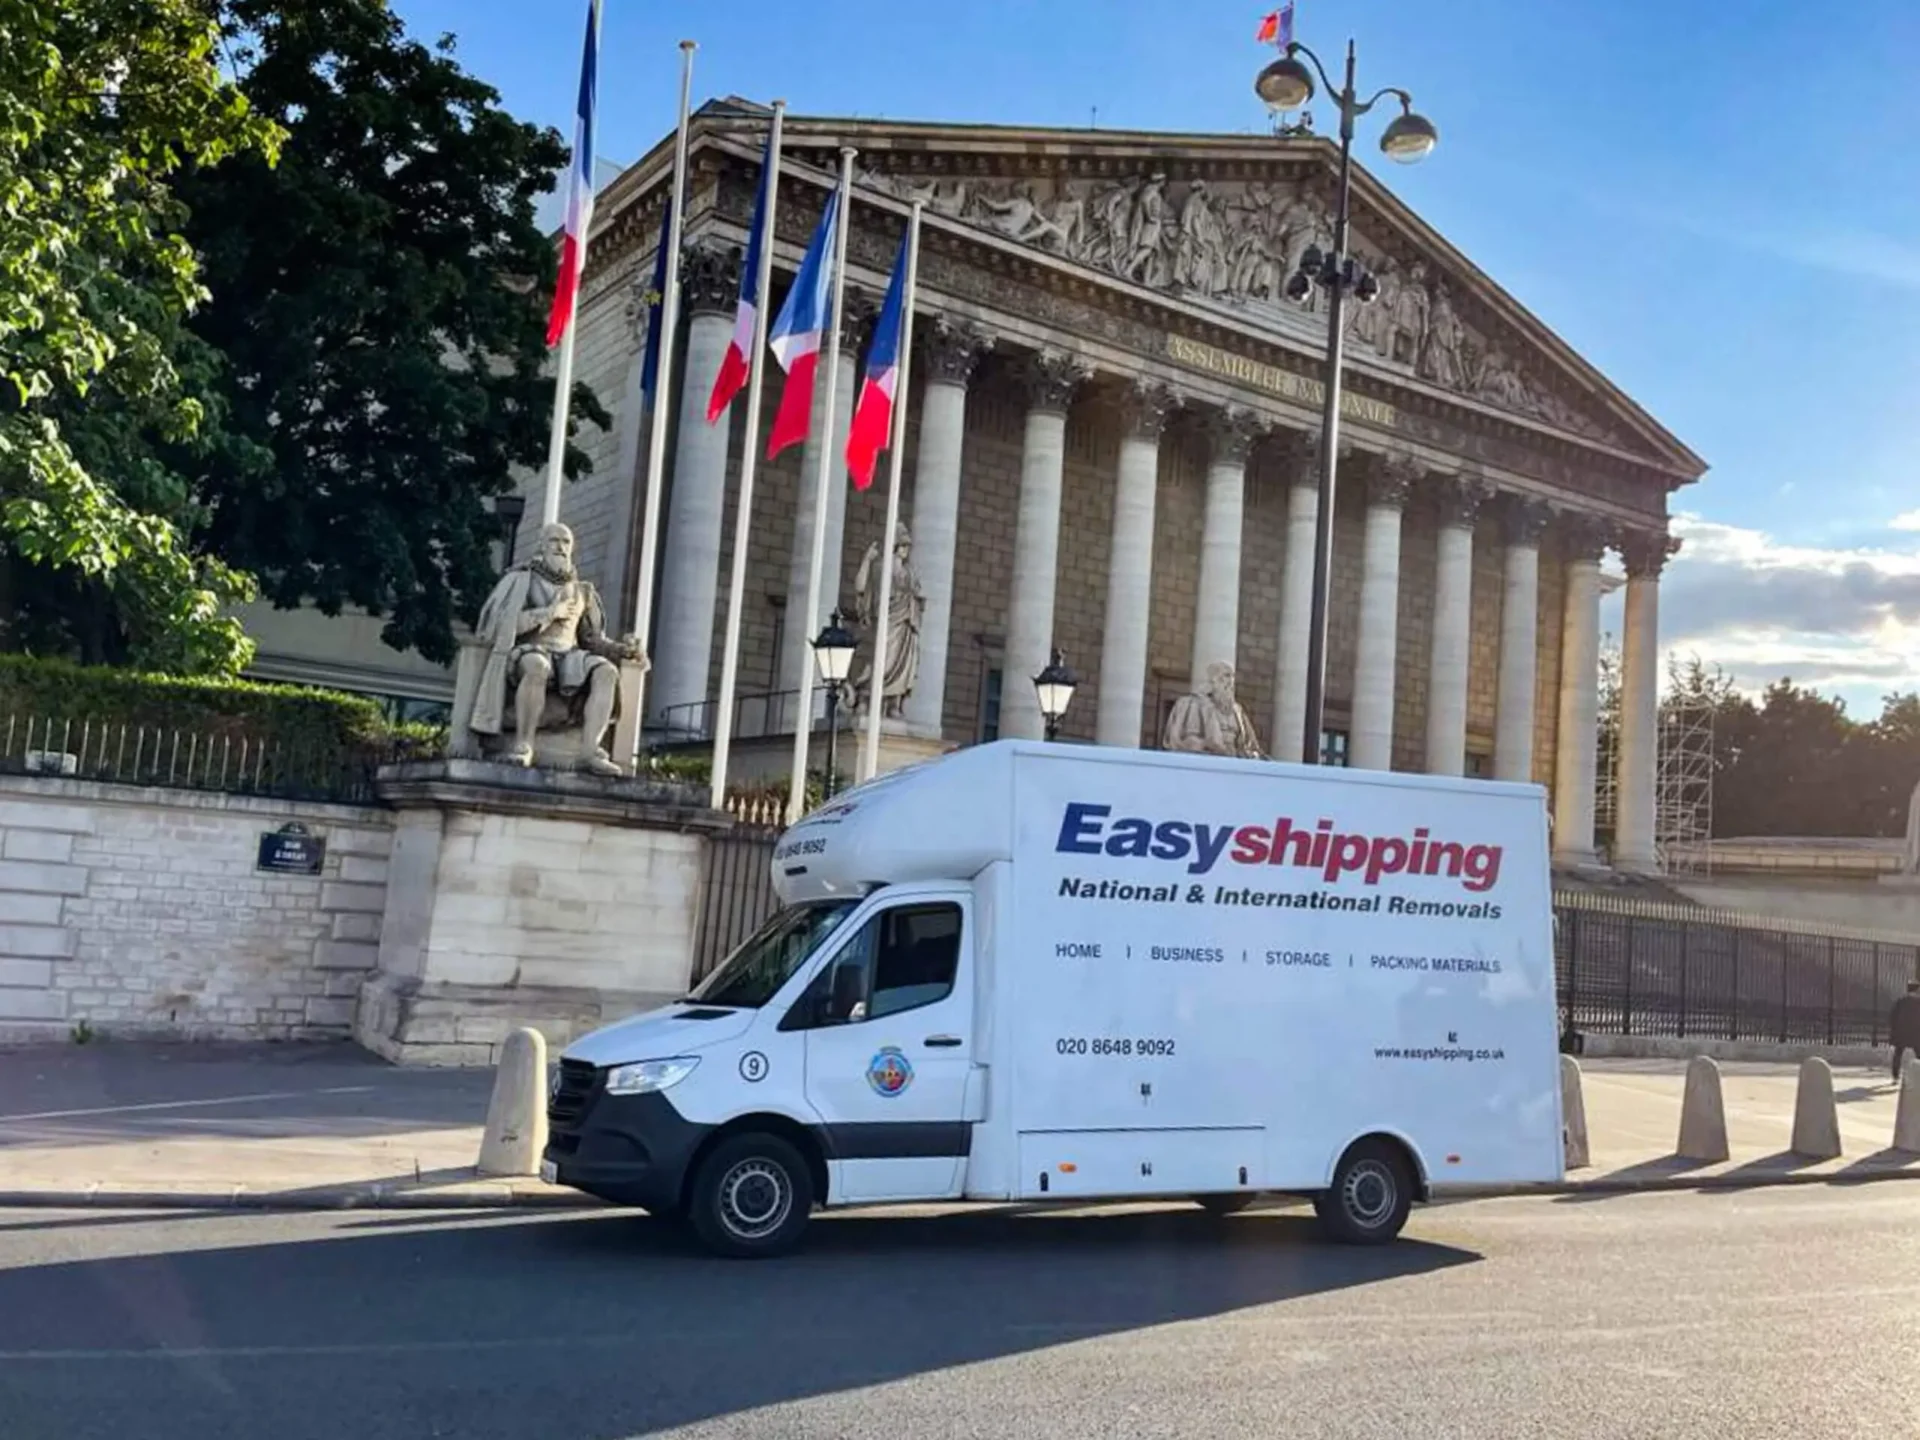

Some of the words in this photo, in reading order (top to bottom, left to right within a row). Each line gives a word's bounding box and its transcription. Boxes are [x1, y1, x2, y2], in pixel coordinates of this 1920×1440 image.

[1055, 802, 1503, 892] Easyshipping
[1058, 878, 1177, 903] National
[1185, 884, 1206, 904] &
[1214, 886, 1381, 913] International
[1388, 897, 1503, 920] Removals
[1055, 943, 1102, 959] HOME
[1150, 945, 1225, 963] BUSINESS
[1265, 950, 1332, 968] STORAGE
[1370, 954, 1429, 971] PACKING
[1432, 957, 1502, 974] MATERIALS
[1056, 1039, 1087, 1056] 020
[1092, 1039, 1132, 1057] 8648
[1136, 1039, 1175, 1057] 9092
[1374, 1045, 1505, 1062] www.easyshipping.co.uk
[749, 1057, 760, 1076] 9
